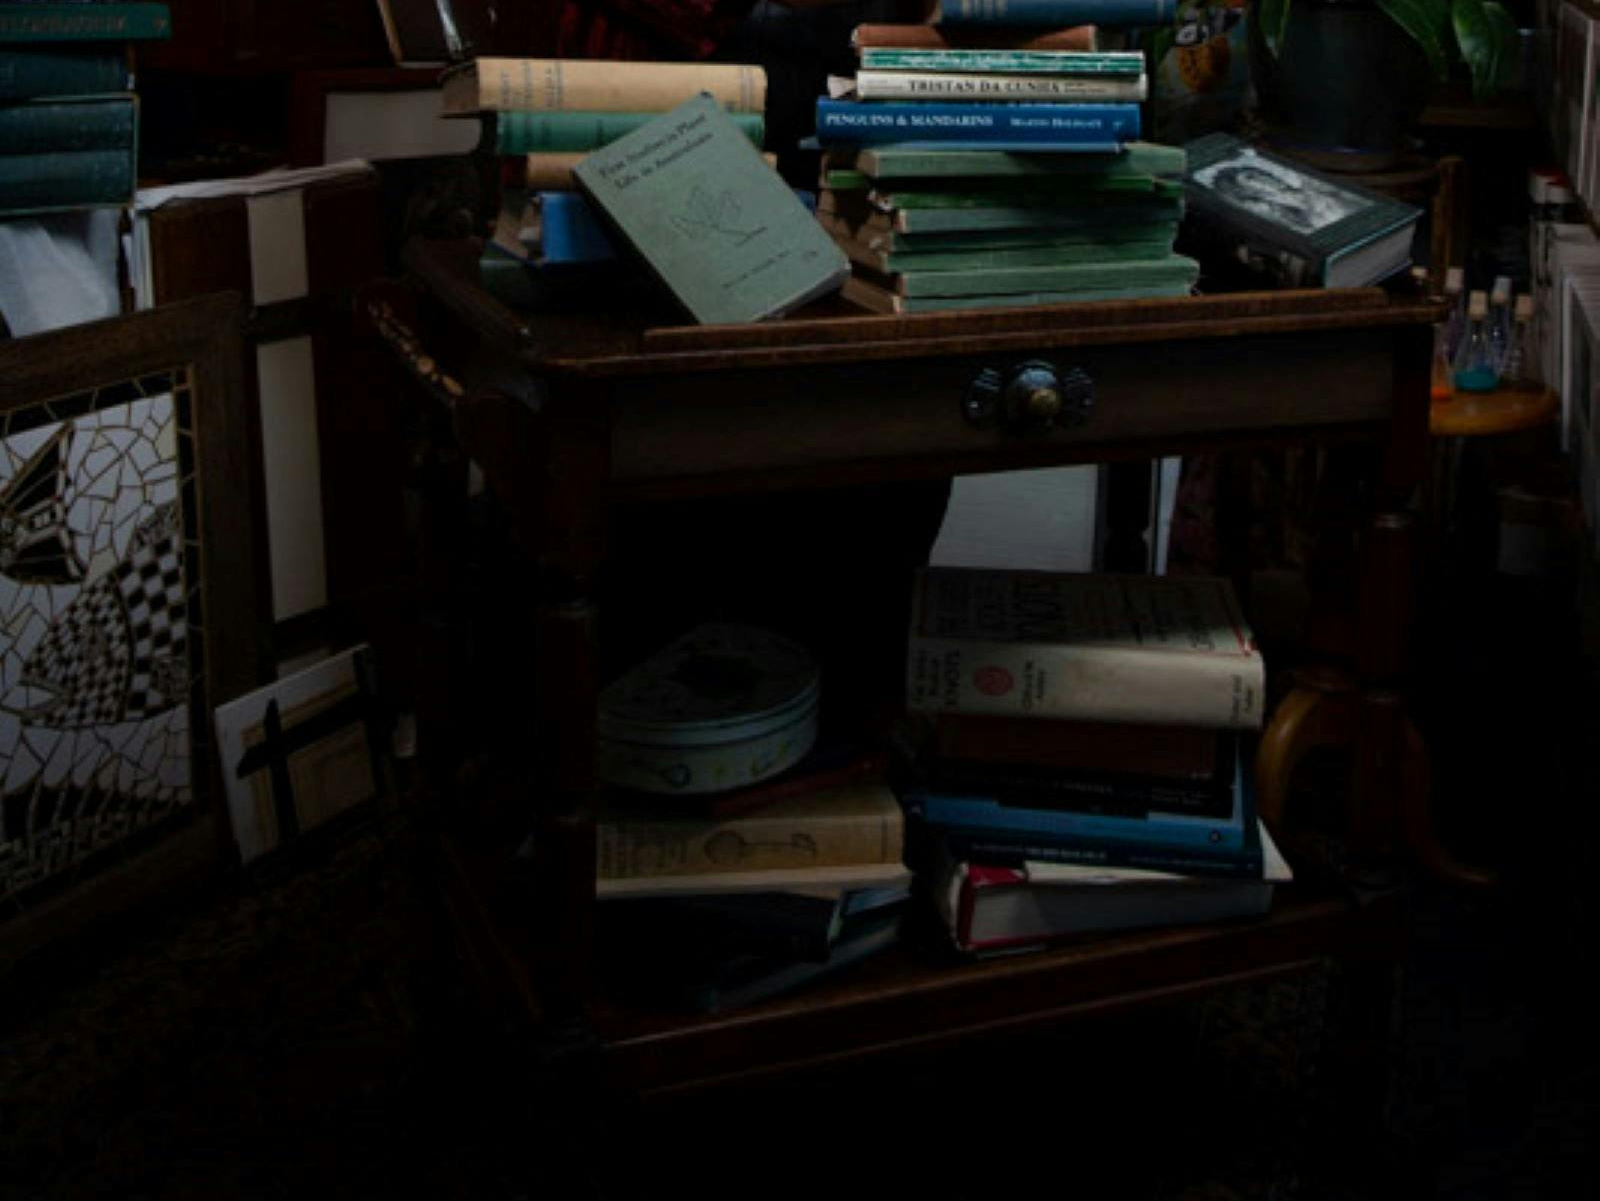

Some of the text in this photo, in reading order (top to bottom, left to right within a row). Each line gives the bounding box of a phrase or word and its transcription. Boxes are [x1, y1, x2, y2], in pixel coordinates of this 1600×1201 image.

[908, 79, 974, 93] TRISTAN
[979, 80, 999, 93] DA
[1004, 80, 1060, 94] CUNHA
[825, 112, 893, 126] PENGUINS
[896, 114, 907, 126] &
[914, 114, 994, 127] MANDARINS
